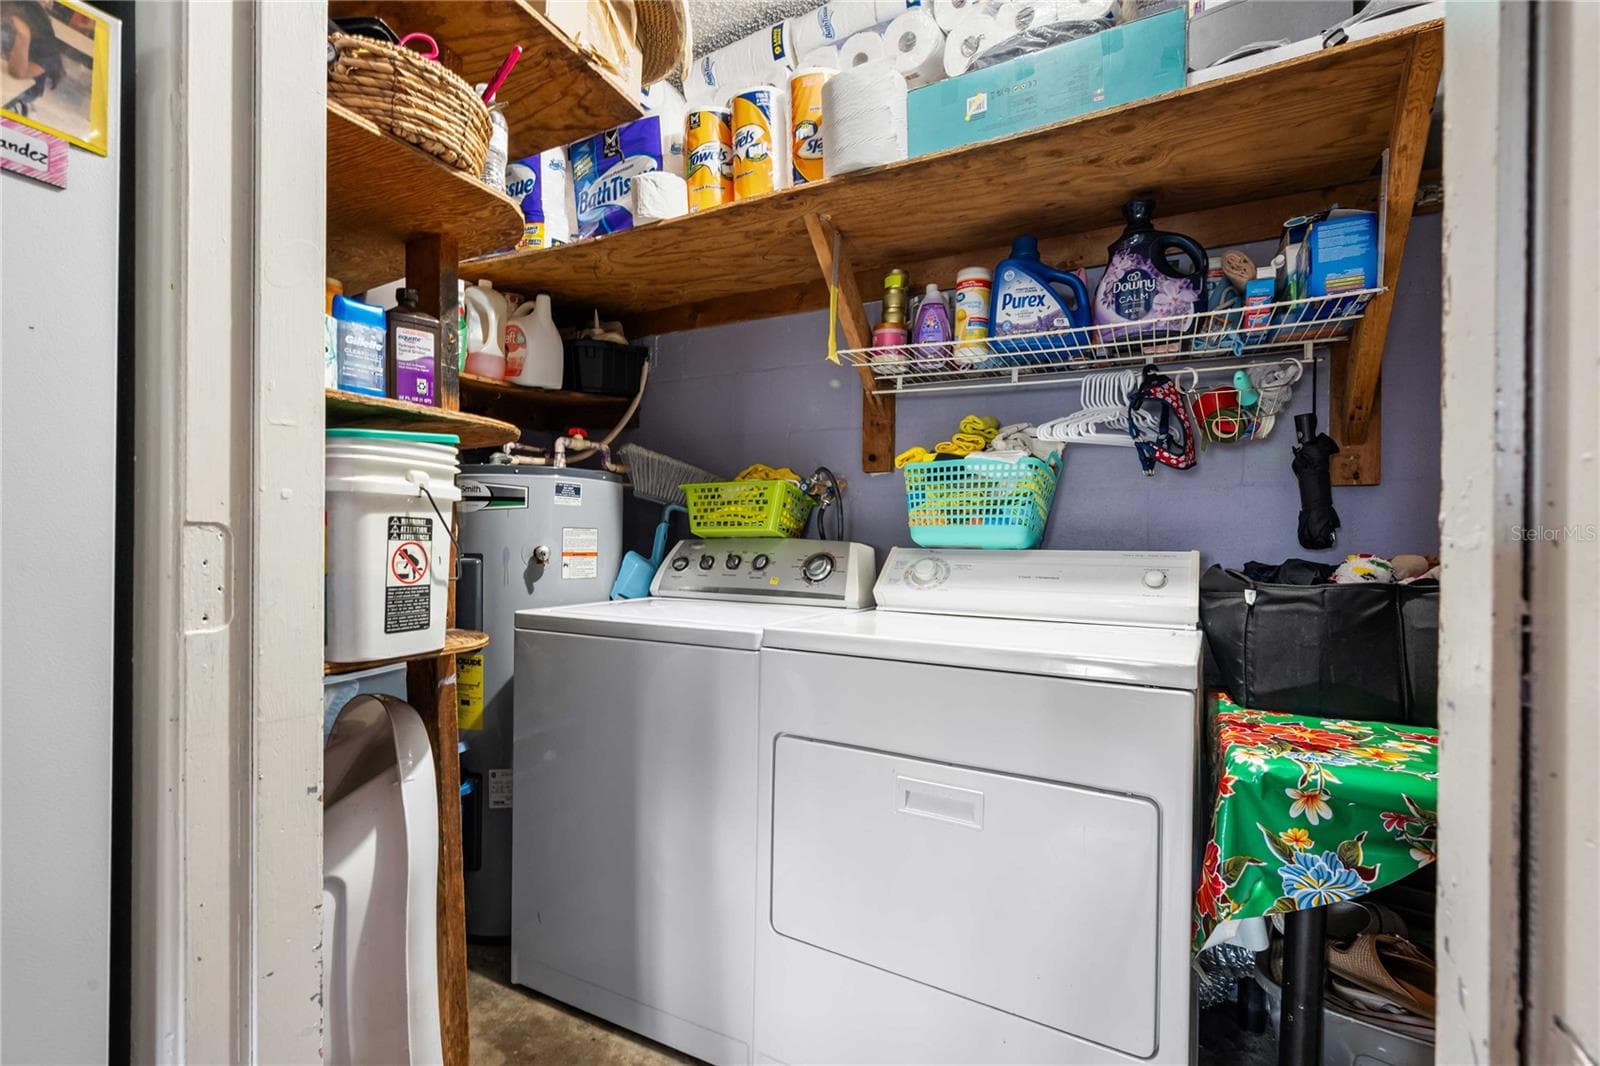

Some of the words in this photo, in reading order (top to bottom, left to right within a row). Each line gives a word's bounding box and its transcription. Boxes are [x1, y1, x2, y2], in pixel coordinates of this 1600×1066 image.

[506, 178, 533, 197] sue
[1113, 279, 1156, 293] Downy
[1002, 293, 1046, 310] Purex
[1119, 292, 1149, 304] CALM
[345, 334, 383, 351] Gillette
[461, 485, 481, 493] Smith
